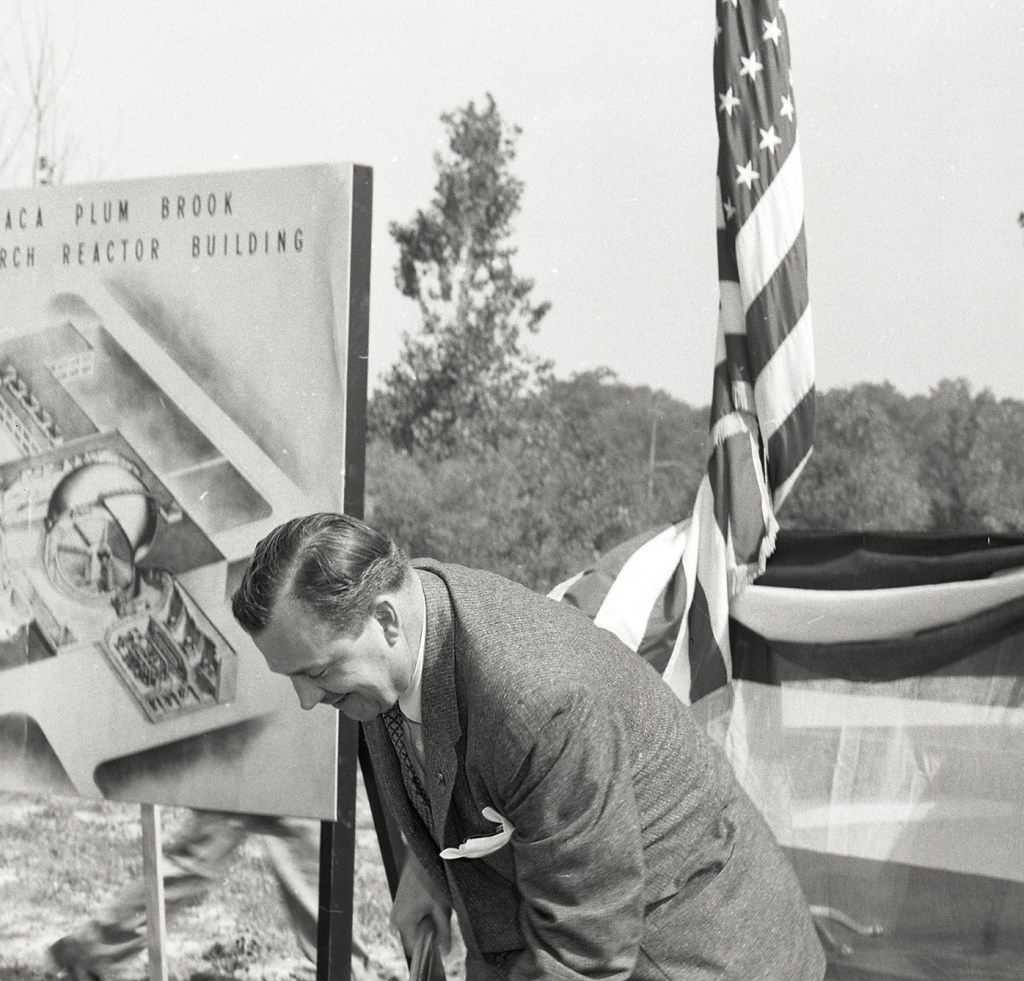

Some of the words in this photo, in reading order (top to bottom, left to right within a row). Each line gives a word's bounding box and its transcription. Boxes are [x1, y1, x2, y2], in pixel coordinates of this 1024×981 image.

[75, 199, 130, 226] PLUM
[161, 191, 234, 220] BROOK
[62, 238, 160, 265] REACTOR
[192, 228, 305, 259] BUILDING
